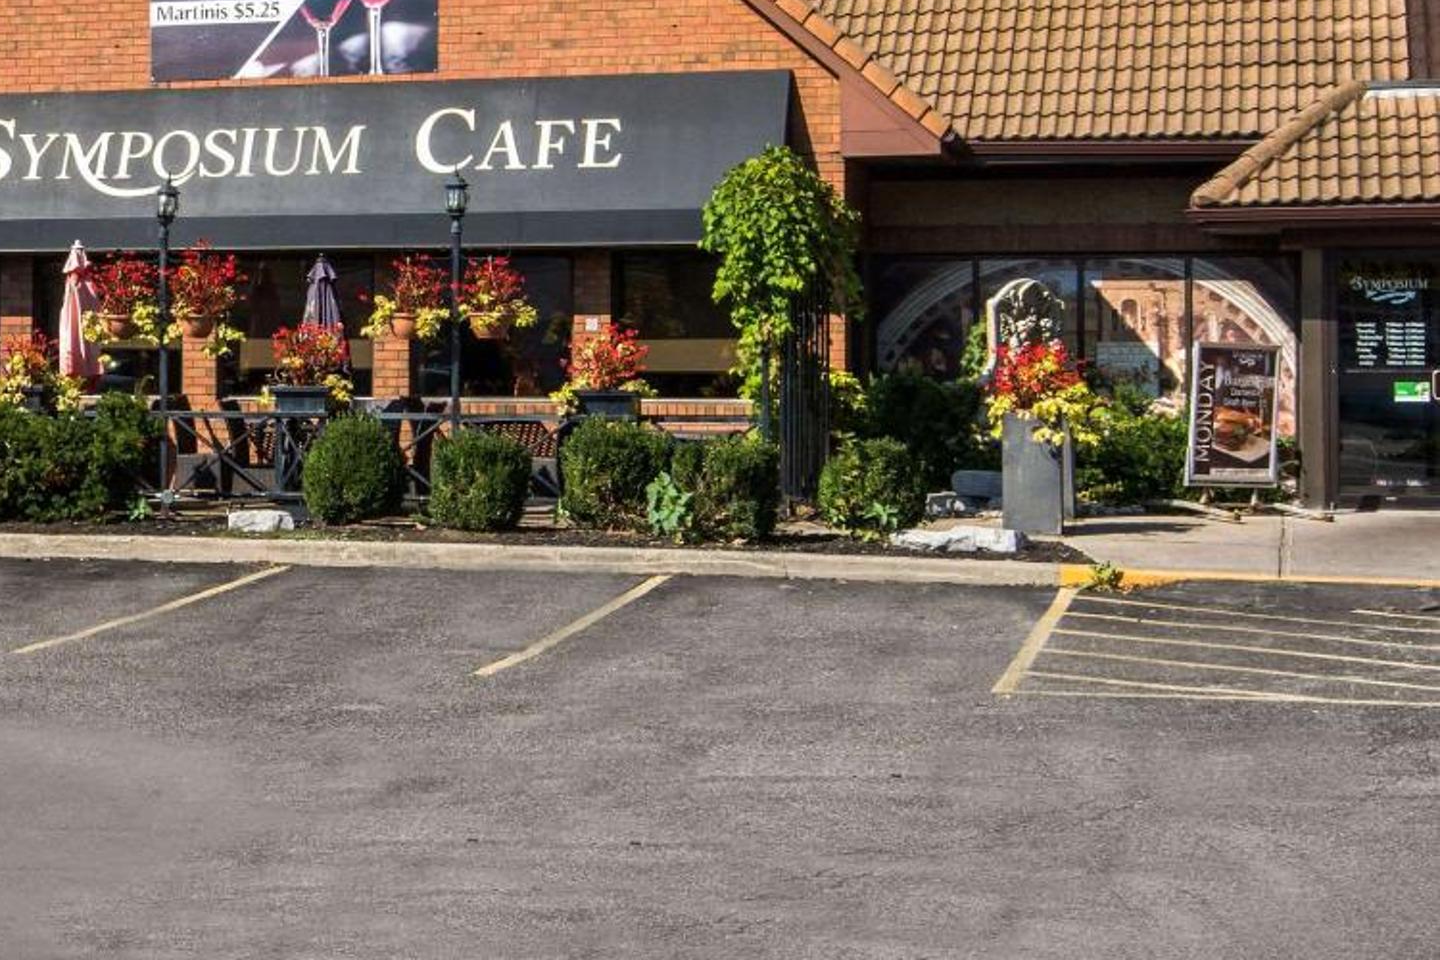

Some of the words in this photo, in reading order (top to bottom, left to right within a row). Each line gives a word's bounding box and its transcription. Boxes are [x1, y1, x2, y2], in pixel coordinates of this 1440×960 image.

[157, 4, 228, 22] Martinis
[234, 1, 280, 19] $5.25
[415, 108, 623, 173] CAFE
[1195, 361, 1215, 462] MONDAY
